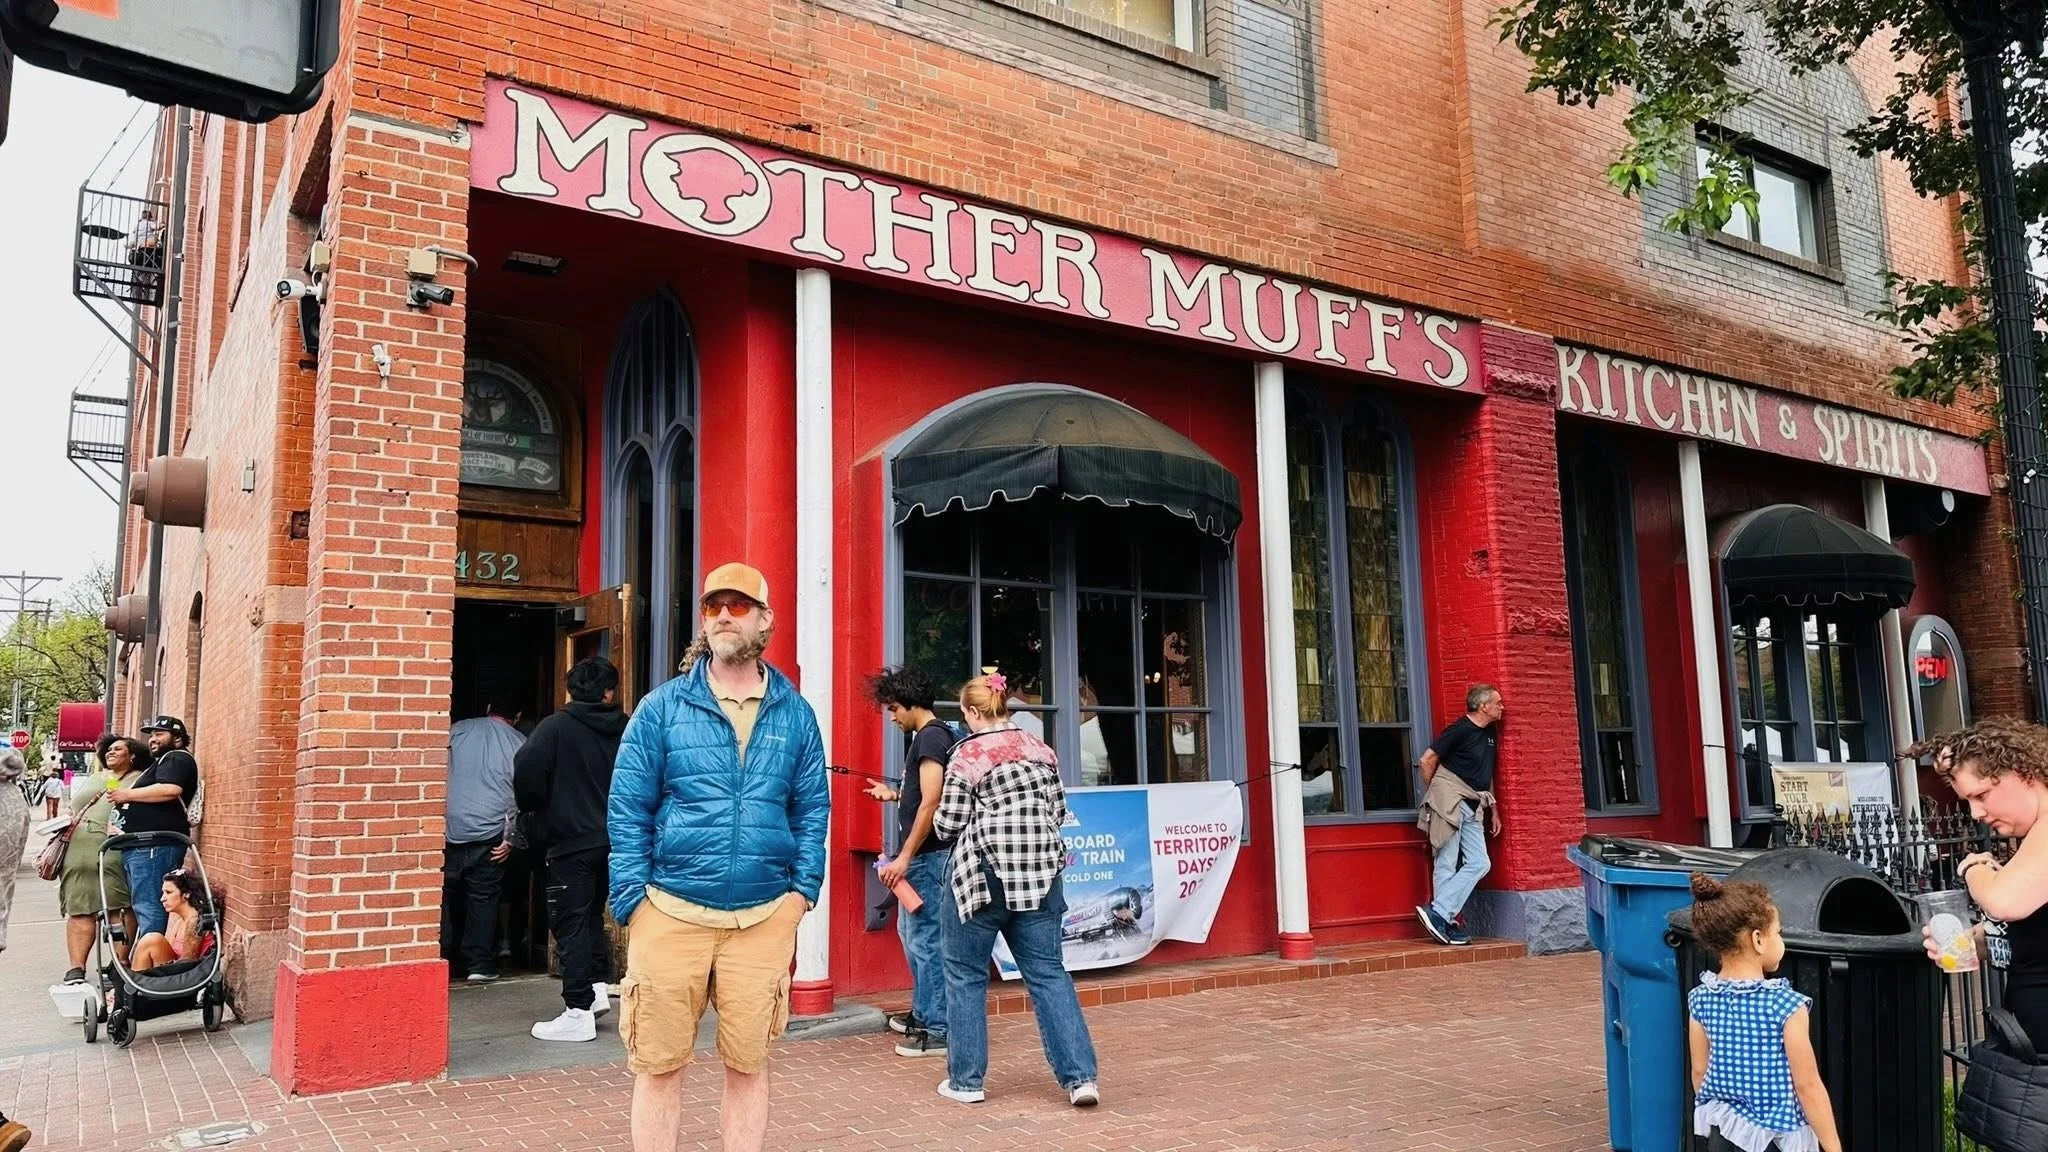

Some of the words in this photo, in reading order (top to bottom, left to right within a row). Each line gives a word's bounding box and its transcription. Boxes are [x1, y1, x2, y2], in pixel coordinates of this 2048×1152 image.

[498, 87, 1111, 319] MOTHER
[1141, 248, 1468, 387] MUFF'S
[1554, 343, 1761, 447] KITCHEN
[1778, 405, 1798, 441] &
[1813, 404, 1938, 484] SPIRITS
[1914, 656, 1946, 679] PEN
[11, 736, 29, 744] STOP
[1780, 781, 1808, 792] START
[1784, 793, 1808, 803] YOUR
[1782, 804, 1814, 815] EGACY
[1165, 824, 1213, 835] WELCOME
[1215, 823, 1228, 832] TO
[1063, 833, 1116, 850] BOARD
[1154, 835, 1236, 855] TERRITORY
[1081, 849, 1126, 865] TRAIN
[1064, 872, 1091, 883] COLD
[1093, 870, 1114, 881] ONE
